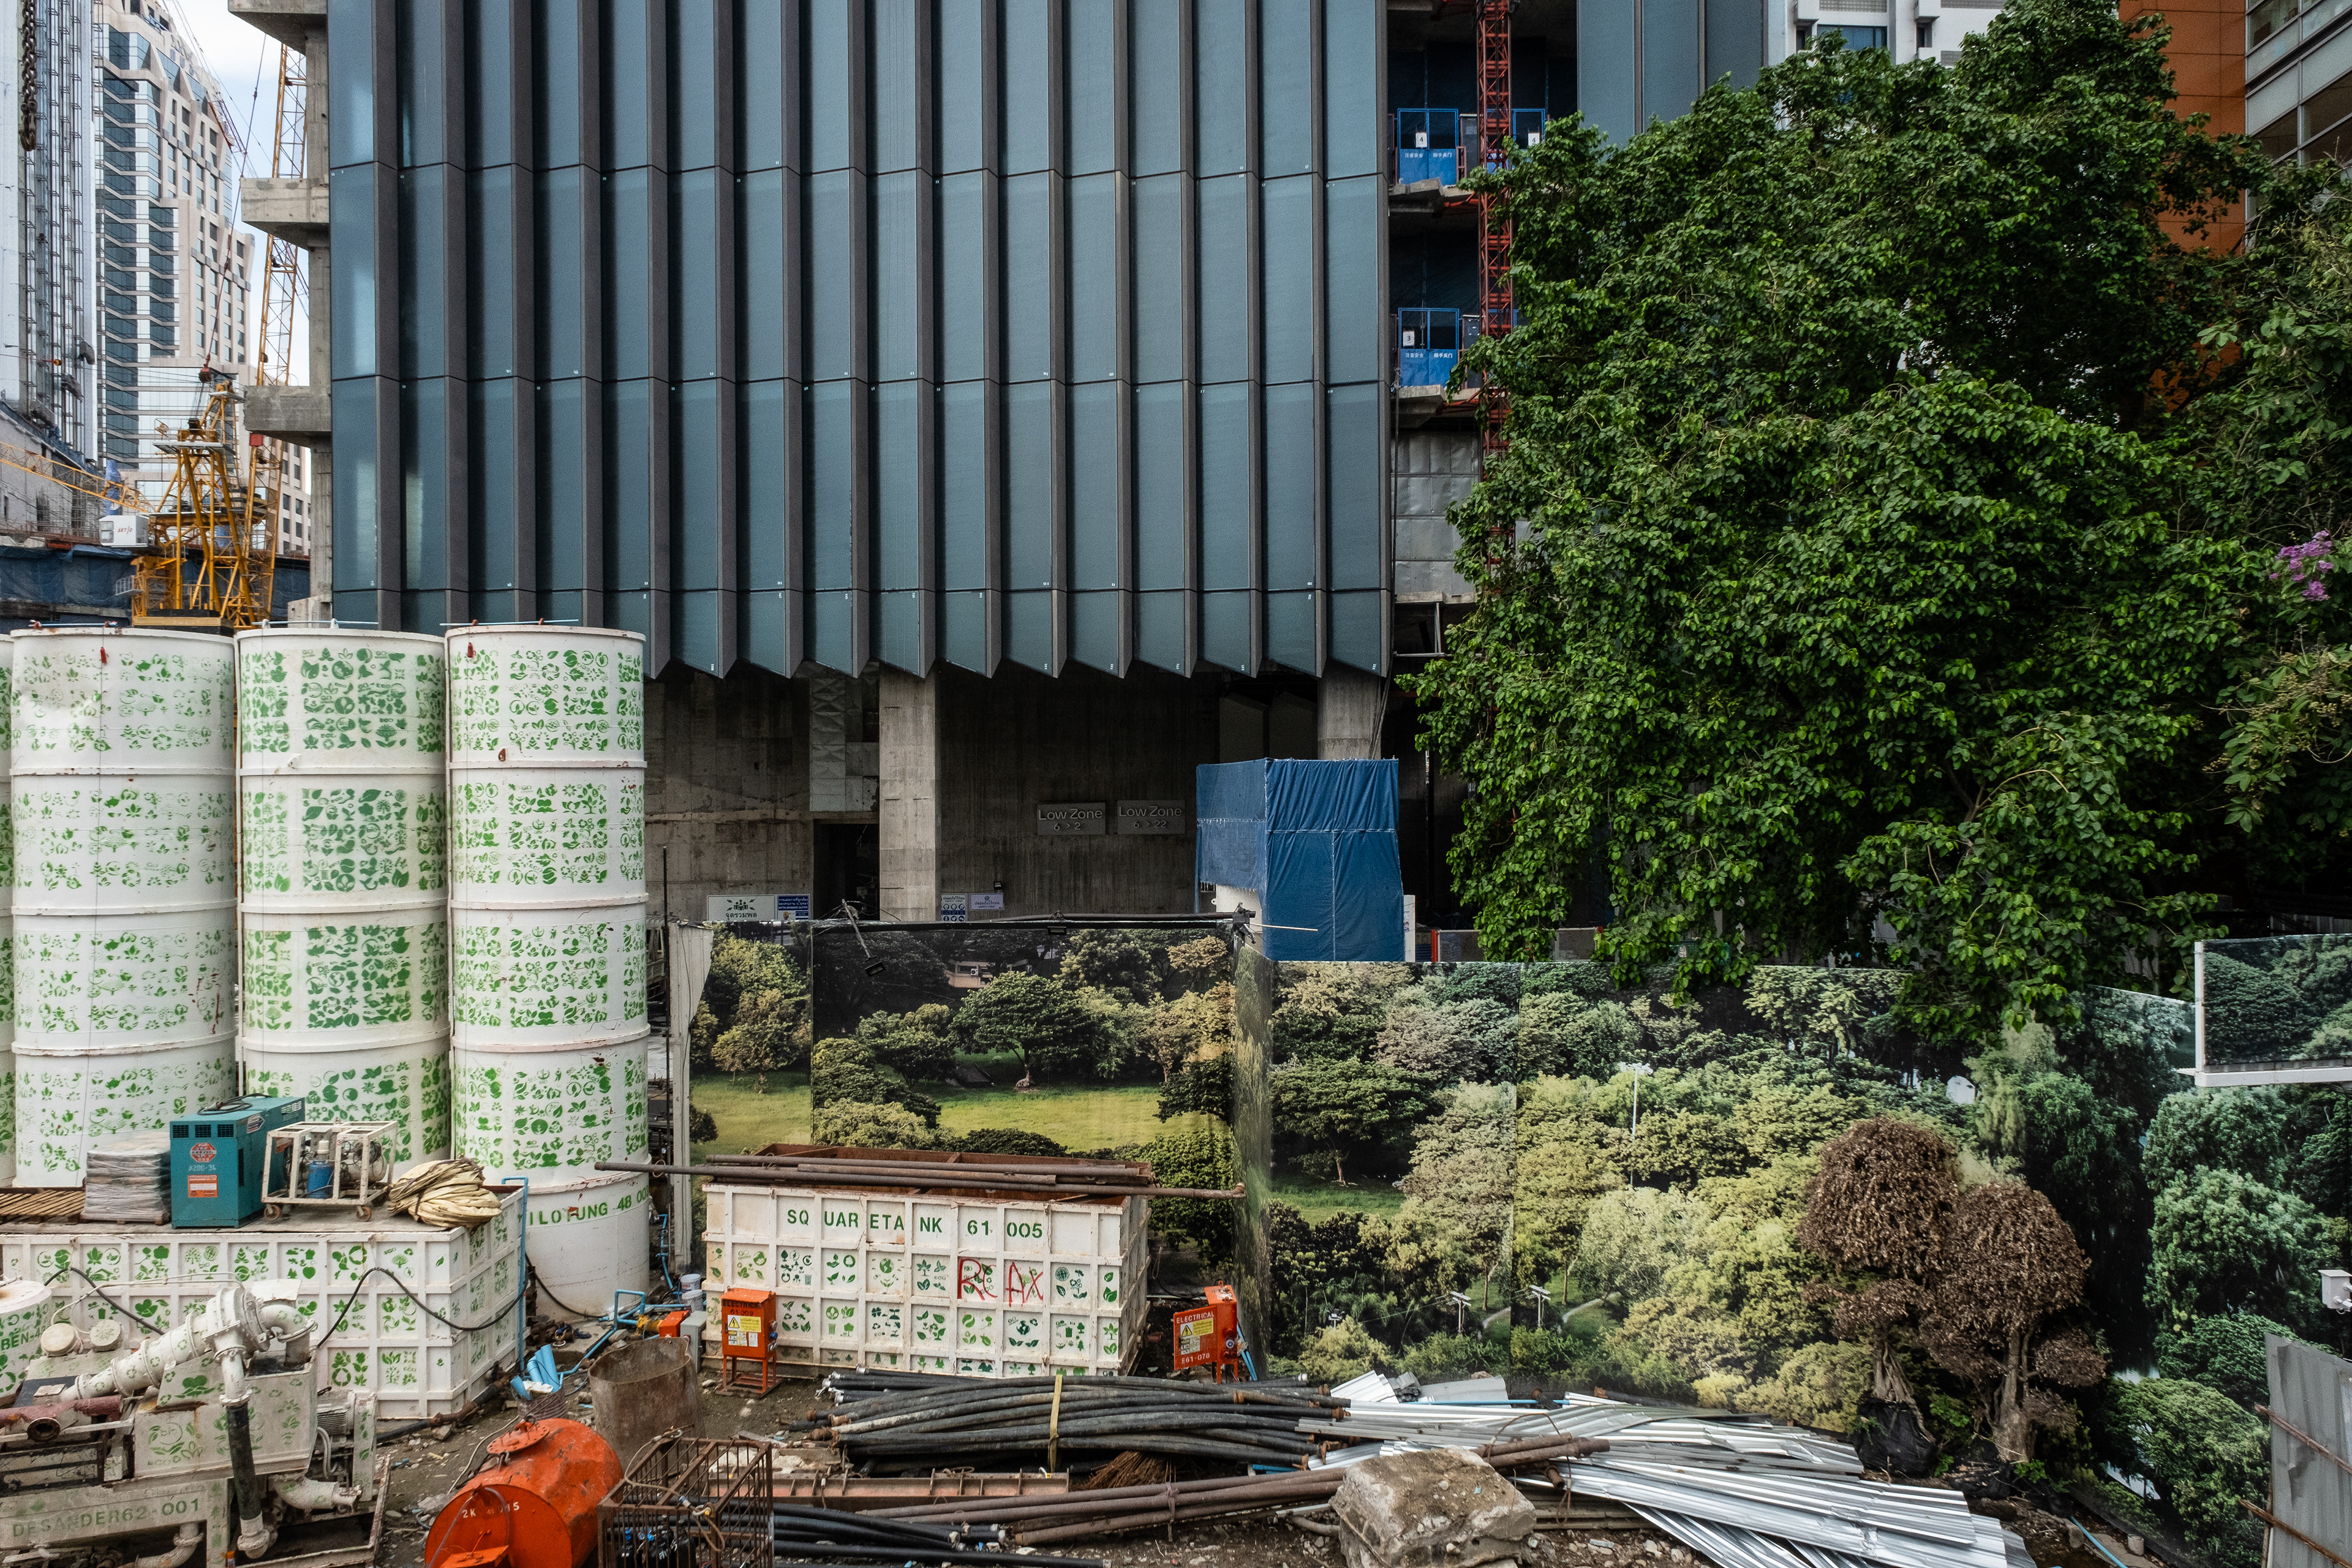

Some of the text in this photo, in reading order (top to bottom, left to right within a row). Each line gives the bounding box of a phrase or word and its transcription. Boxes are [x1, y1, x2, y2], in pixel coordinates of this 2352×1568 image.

[1038, 809, 1102, 820] Low Zone
[1119, 805, 1182, 817] Low Zone
[1054, 823, 1060, 831] 6
[1154, 820, 1167, 829] 22
[725, 912, 758, 921] จุดรวมพล
[616, 1194, 631, 1211] 48
[967, 1219, 989, 1236] 61
[1006, 1221, 1043, 1238] 005
[723, 1298, 762, 1309] ELECTRICAL
[1176, 1311, 1215, 1324] ELECTRICAL
